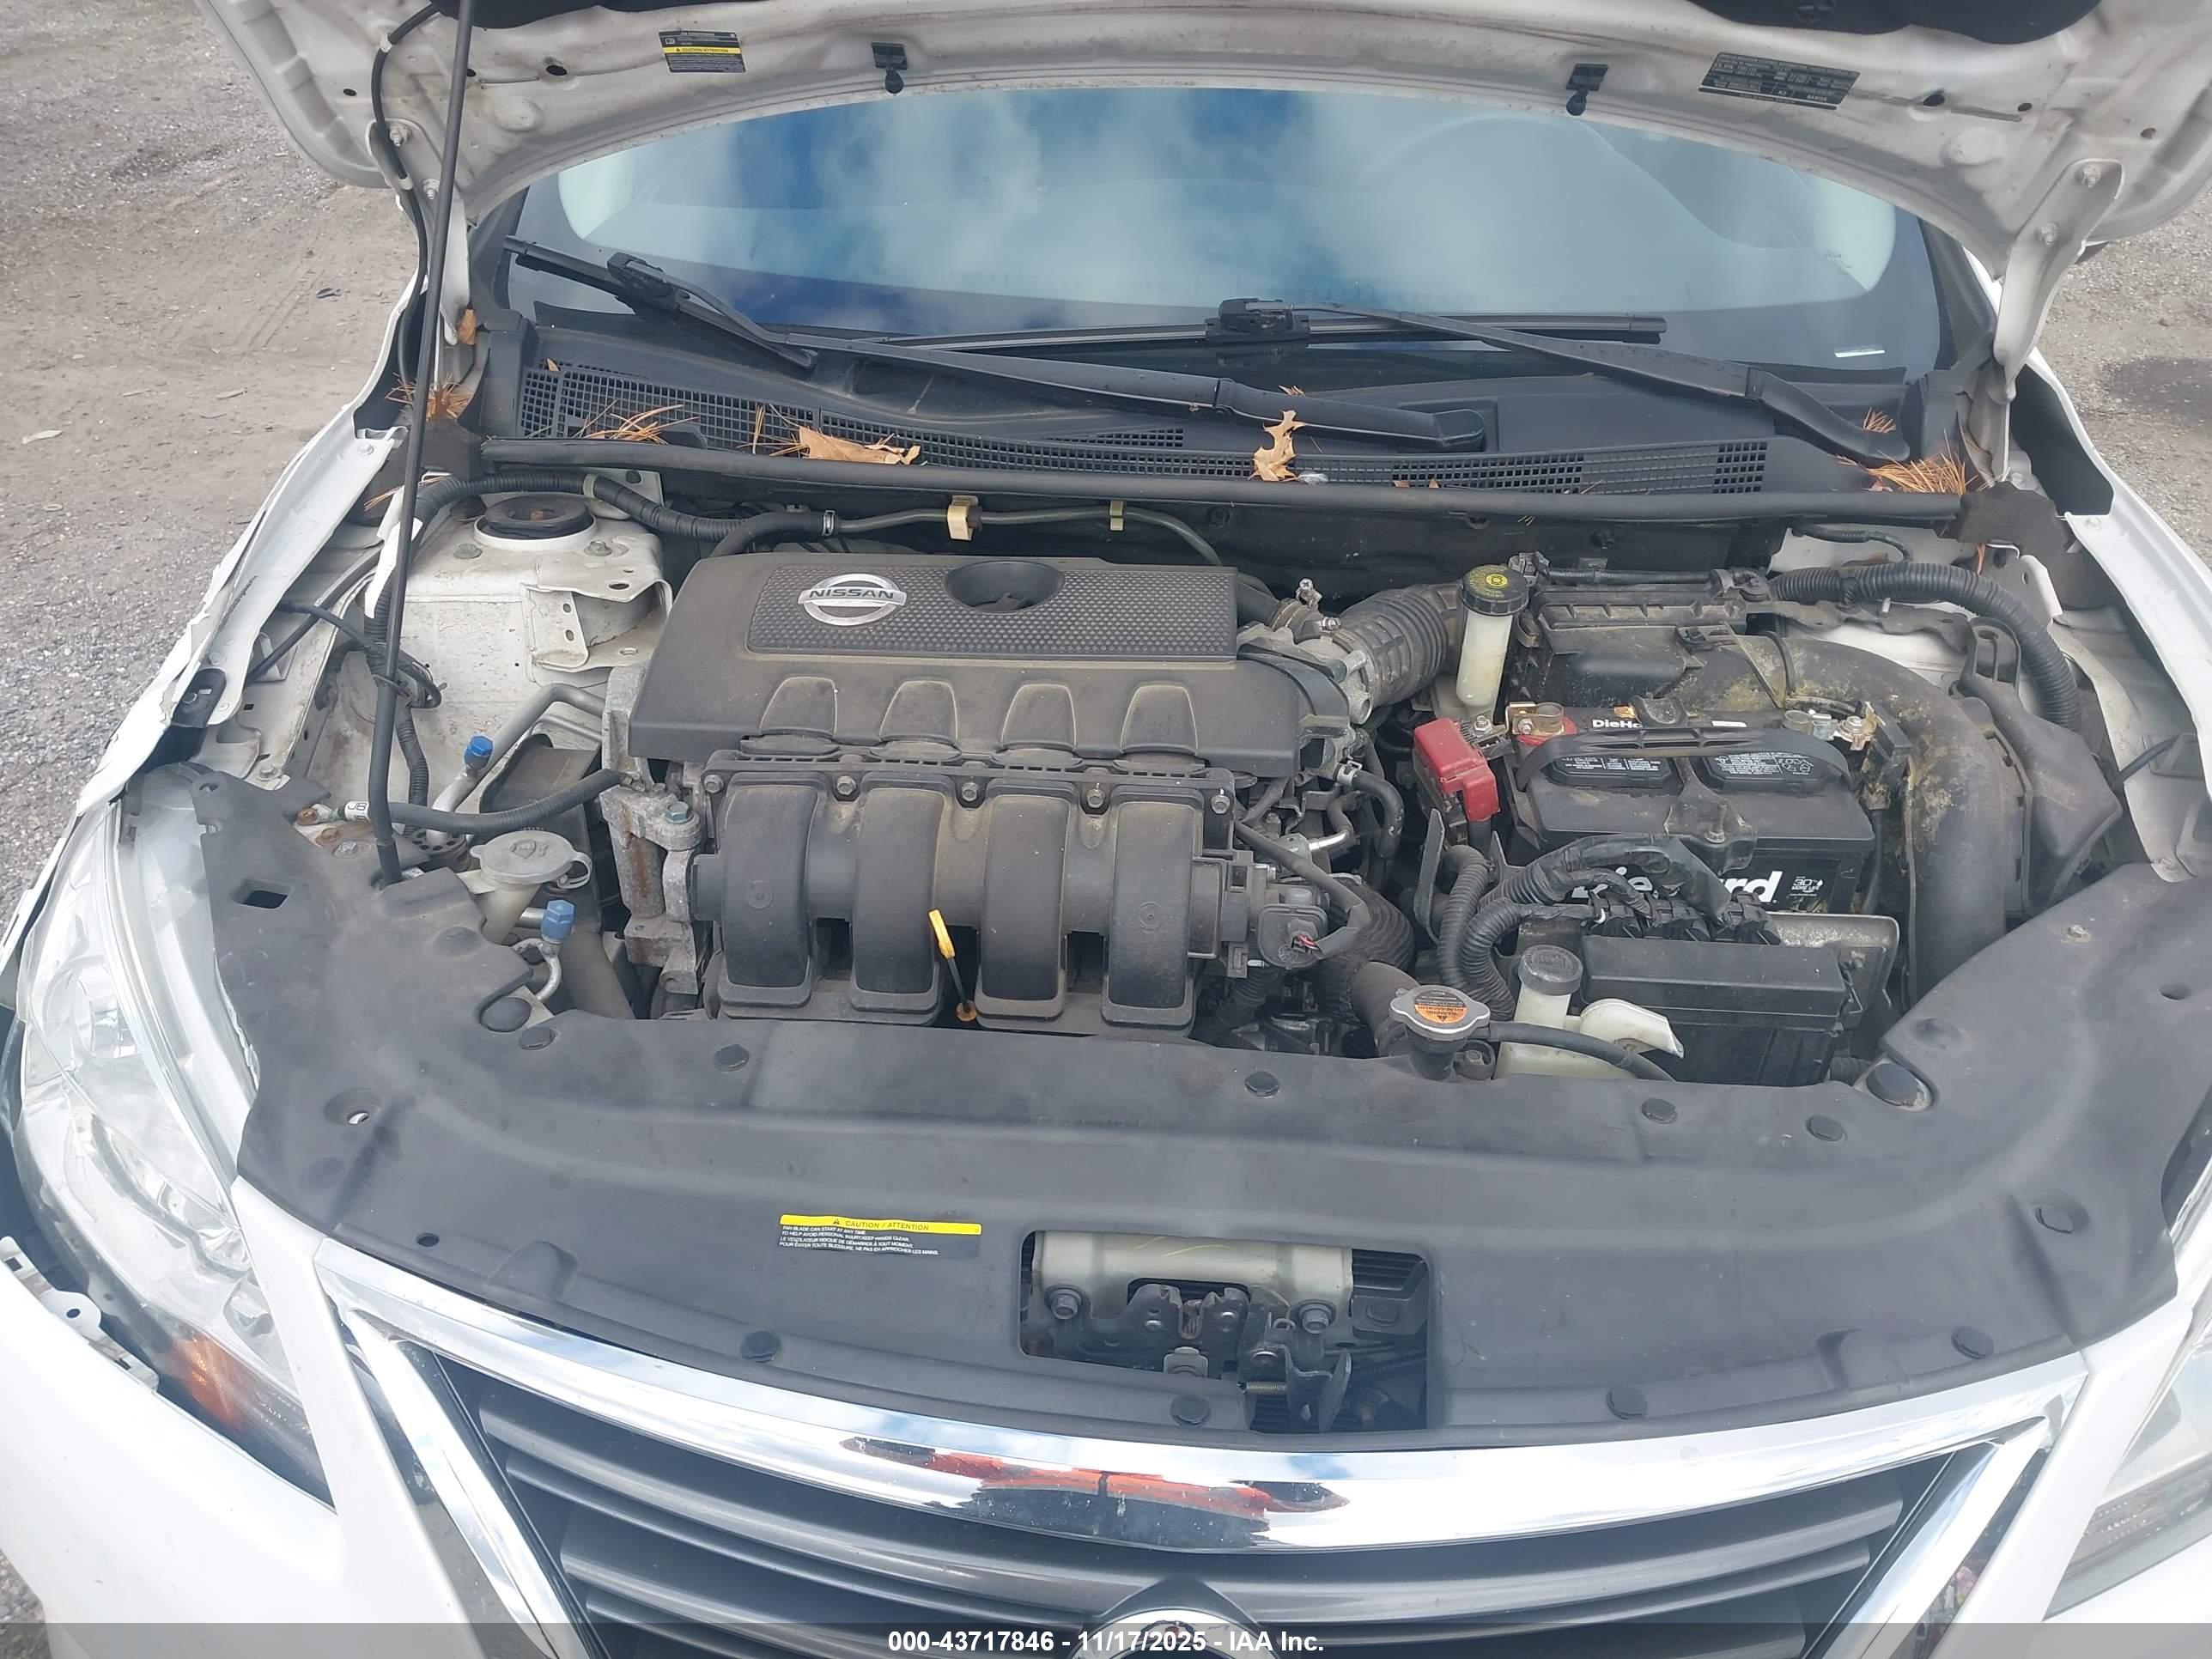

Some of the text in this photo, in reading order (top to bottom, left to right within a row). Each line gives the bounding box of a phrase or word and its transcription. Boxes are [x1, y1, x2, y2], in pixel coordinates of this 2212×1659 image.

[809, 588, 895, 599] NISSAN
[845, 1220, 880, 1229] CAUTION
[887, 1222, 929, 1231] ATTENTION
